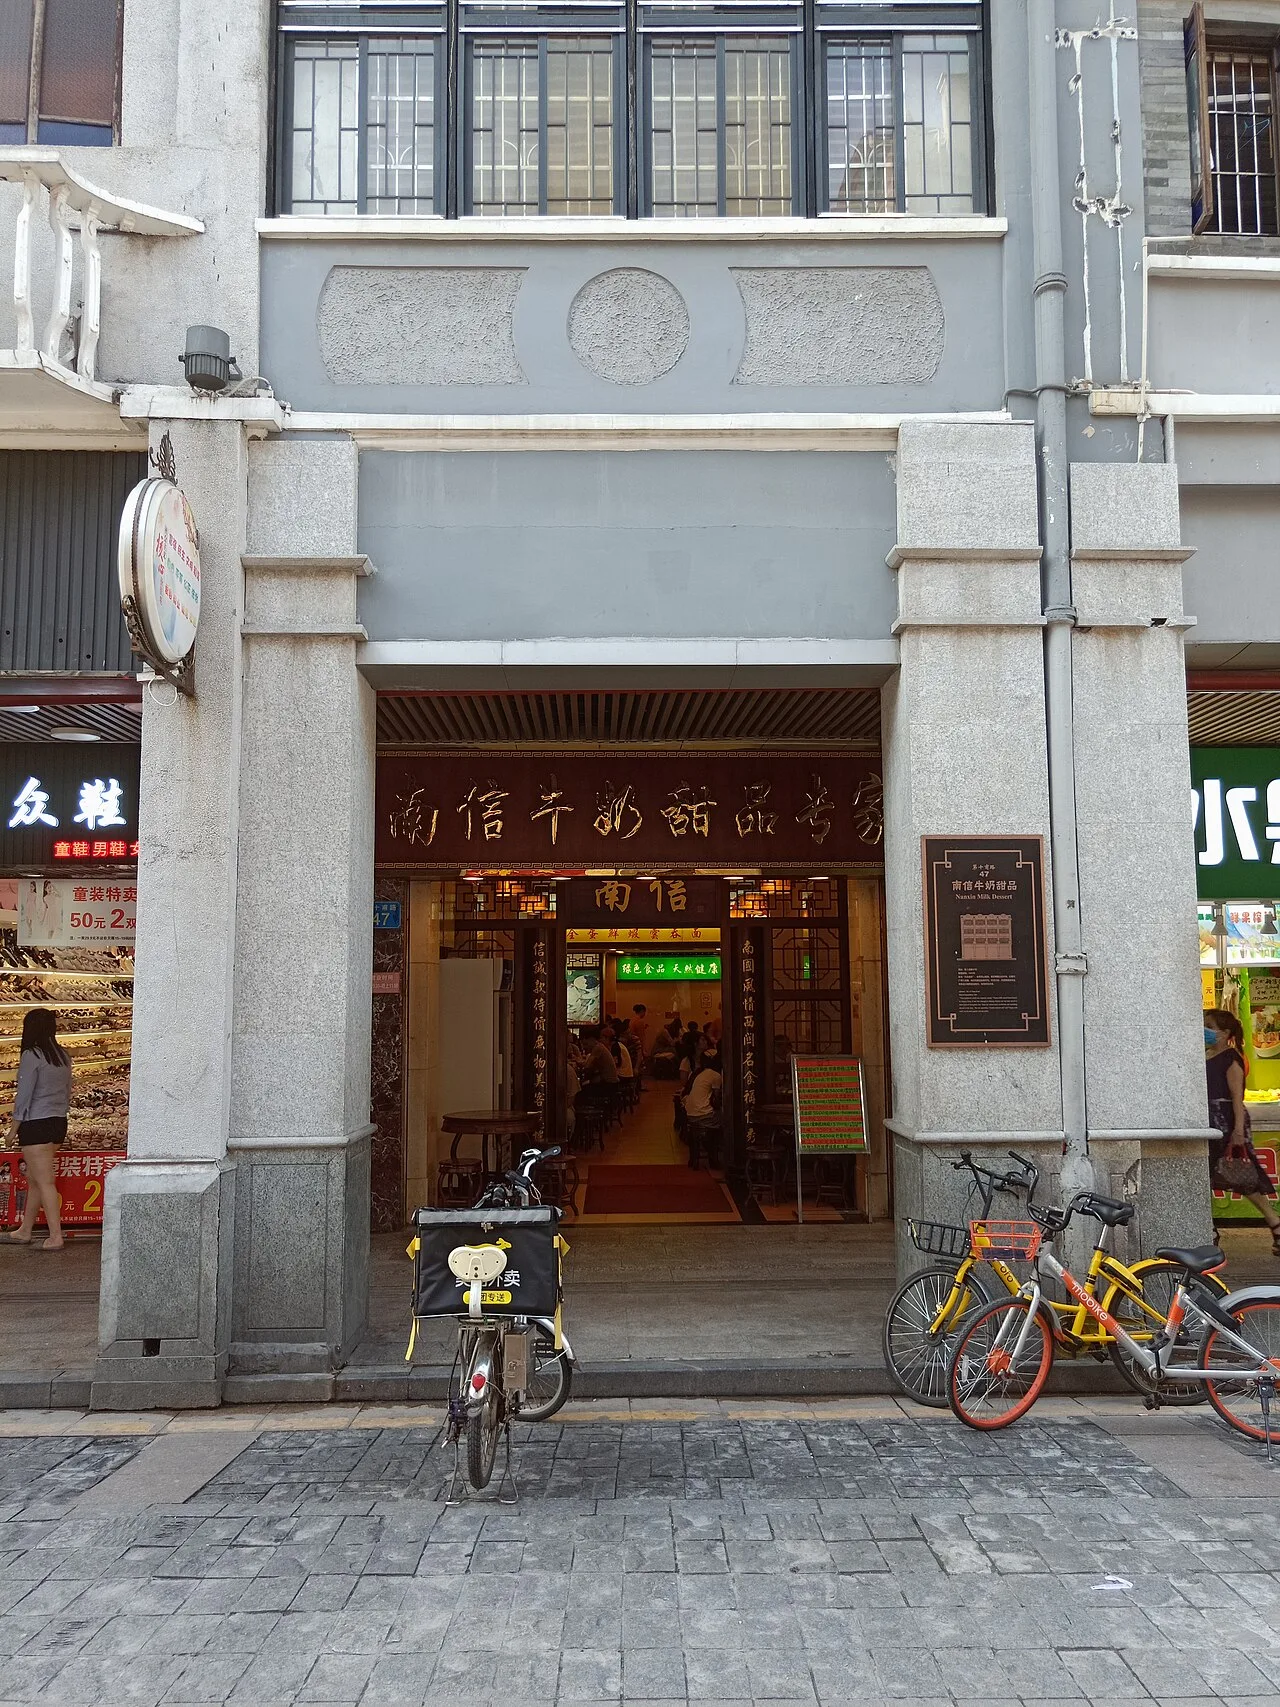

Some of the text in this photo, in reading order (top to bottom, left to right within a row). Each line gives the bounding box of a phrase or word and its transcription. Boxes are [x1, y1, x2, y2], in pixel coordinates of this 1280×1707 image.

[1191, 778, 1280, 866] 水
[951, 880, 1017, 891] 南信牛奶甜品
[73, 886, 137, 902] 童装特卖
[595, 880, 687, 913] 南信
[373, 912, 390, 926] 47
[1230, 910, 1275, 925] 鲜果榨
[672, 962, 719, 975] 天然健康
[1071, 1280, 1108, 1321] mobike
